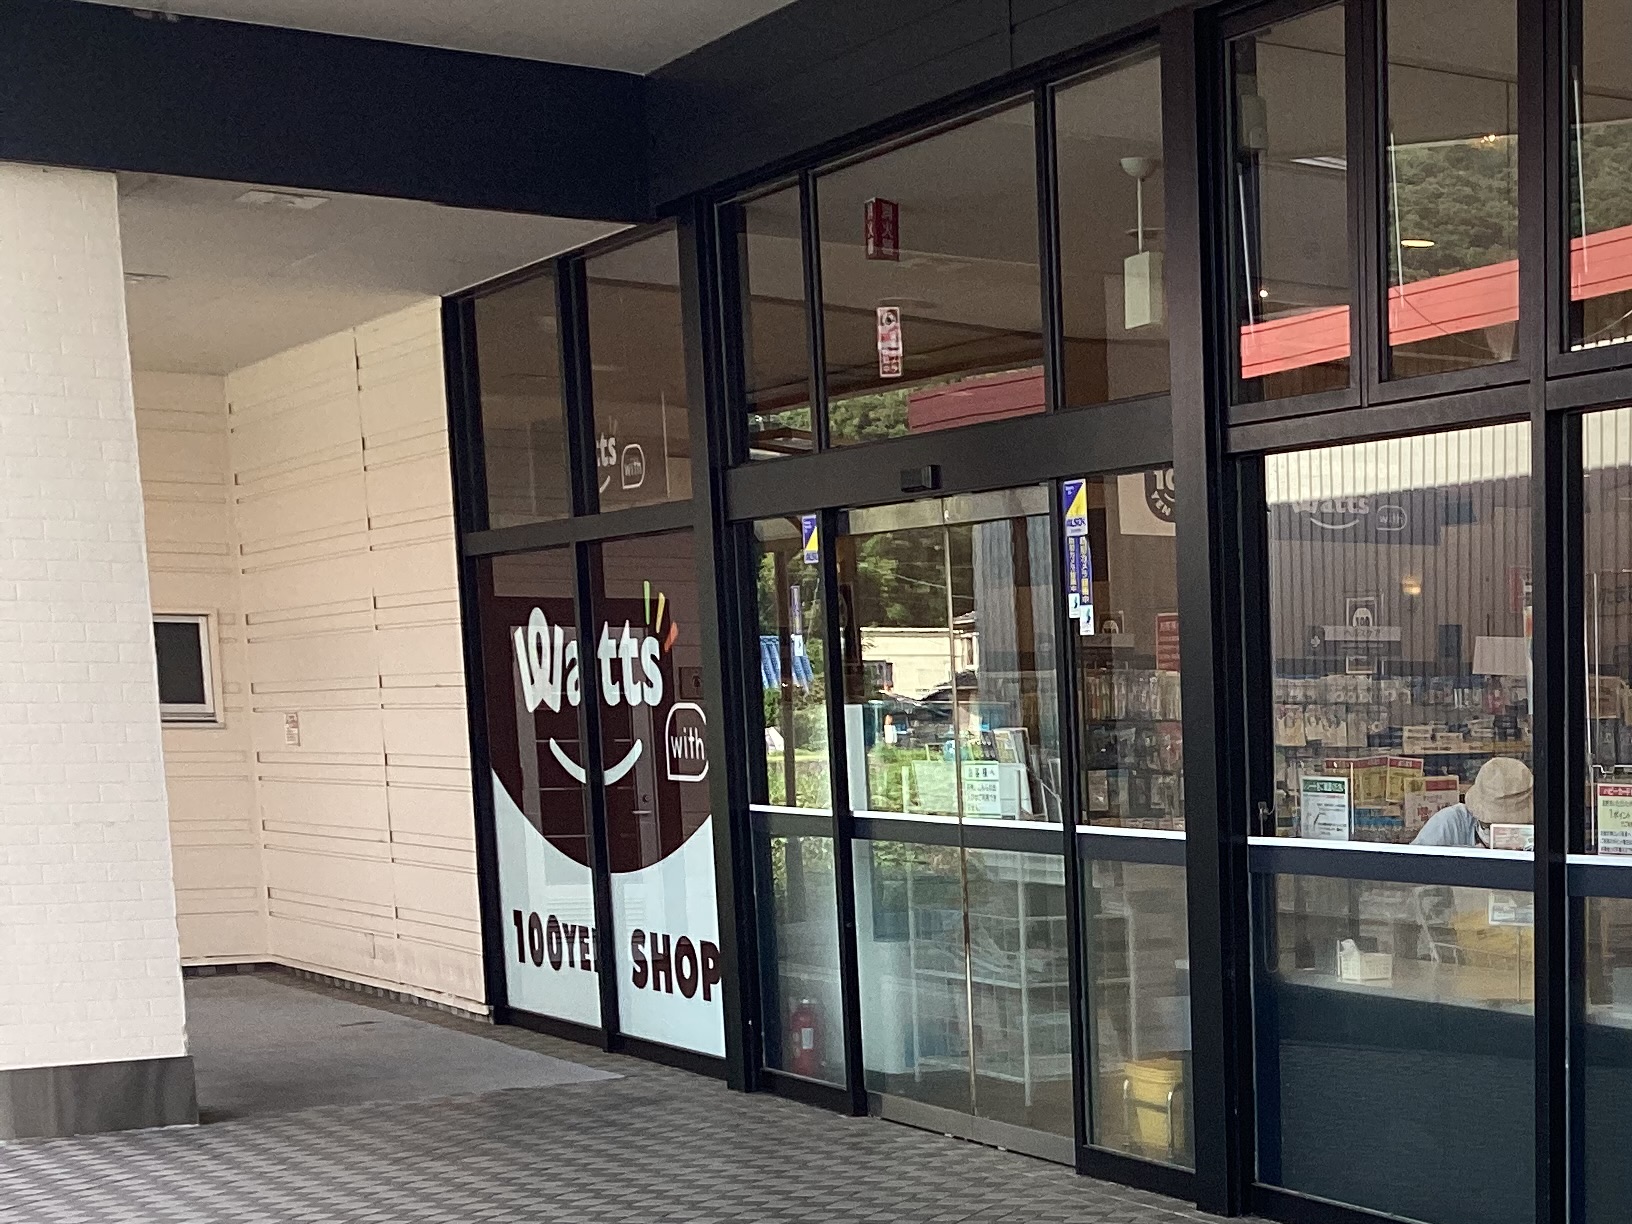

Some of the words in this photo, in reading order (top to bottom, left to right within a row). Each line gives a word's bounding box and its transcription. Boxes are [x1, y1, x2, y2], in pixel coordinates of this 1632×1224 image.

[514, 607, 663, 713] Watts
[670, 726, 706, 760] with
[513, 910, 598, 972] 100YE
[631, 929, 721, 1002] SHOP
